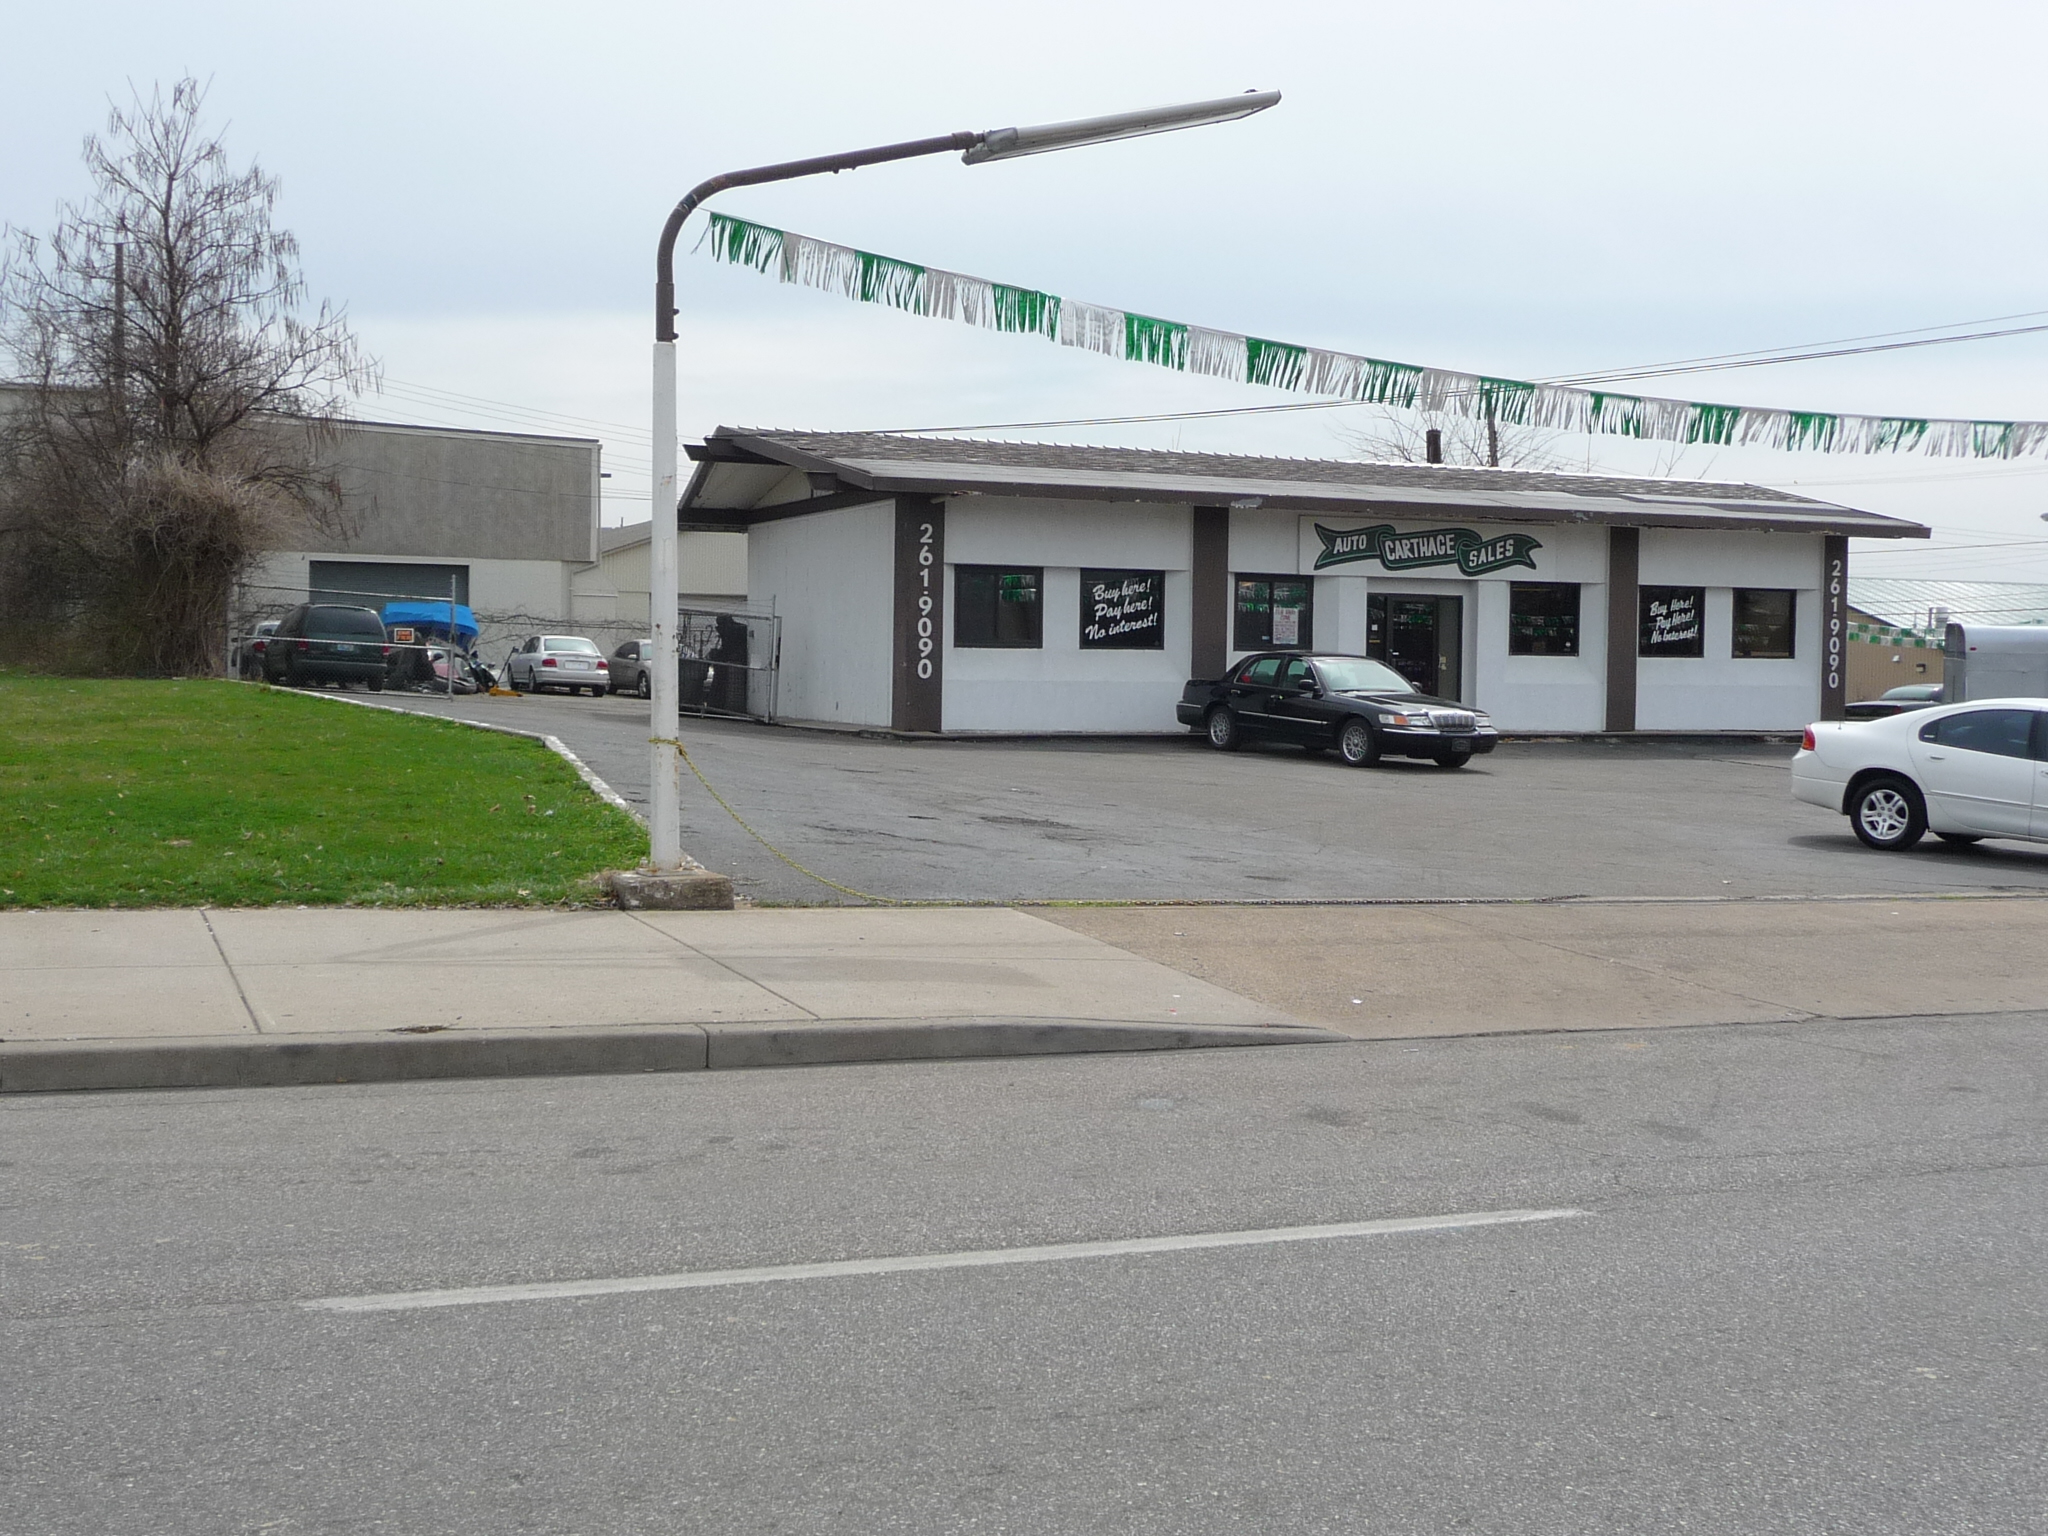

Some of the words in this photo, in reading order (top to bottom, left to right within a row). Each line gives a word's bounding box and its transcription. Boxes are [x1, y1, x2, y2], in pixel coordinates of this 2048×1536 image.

[1333, 534, 1367, 554] AUTO
[1384, 534, 1455, 561] CARTHAGE
[1468, 539, 1514, 567] SALES
[1092, 584, 1120, 602] Buy
[1121, 578, 1151, 596] here!
[1094, 603, 1122, 621] Pay
[1123, 596, 1153, 614] here!
[1650, 601, 1667, 616] Buy
[1085, 623, 1106, 640] No
[1108, 612, 1158, 636] interest!
[1656, 616, 1671, 631] Pay
[1650, 630, 1662, 644] No
